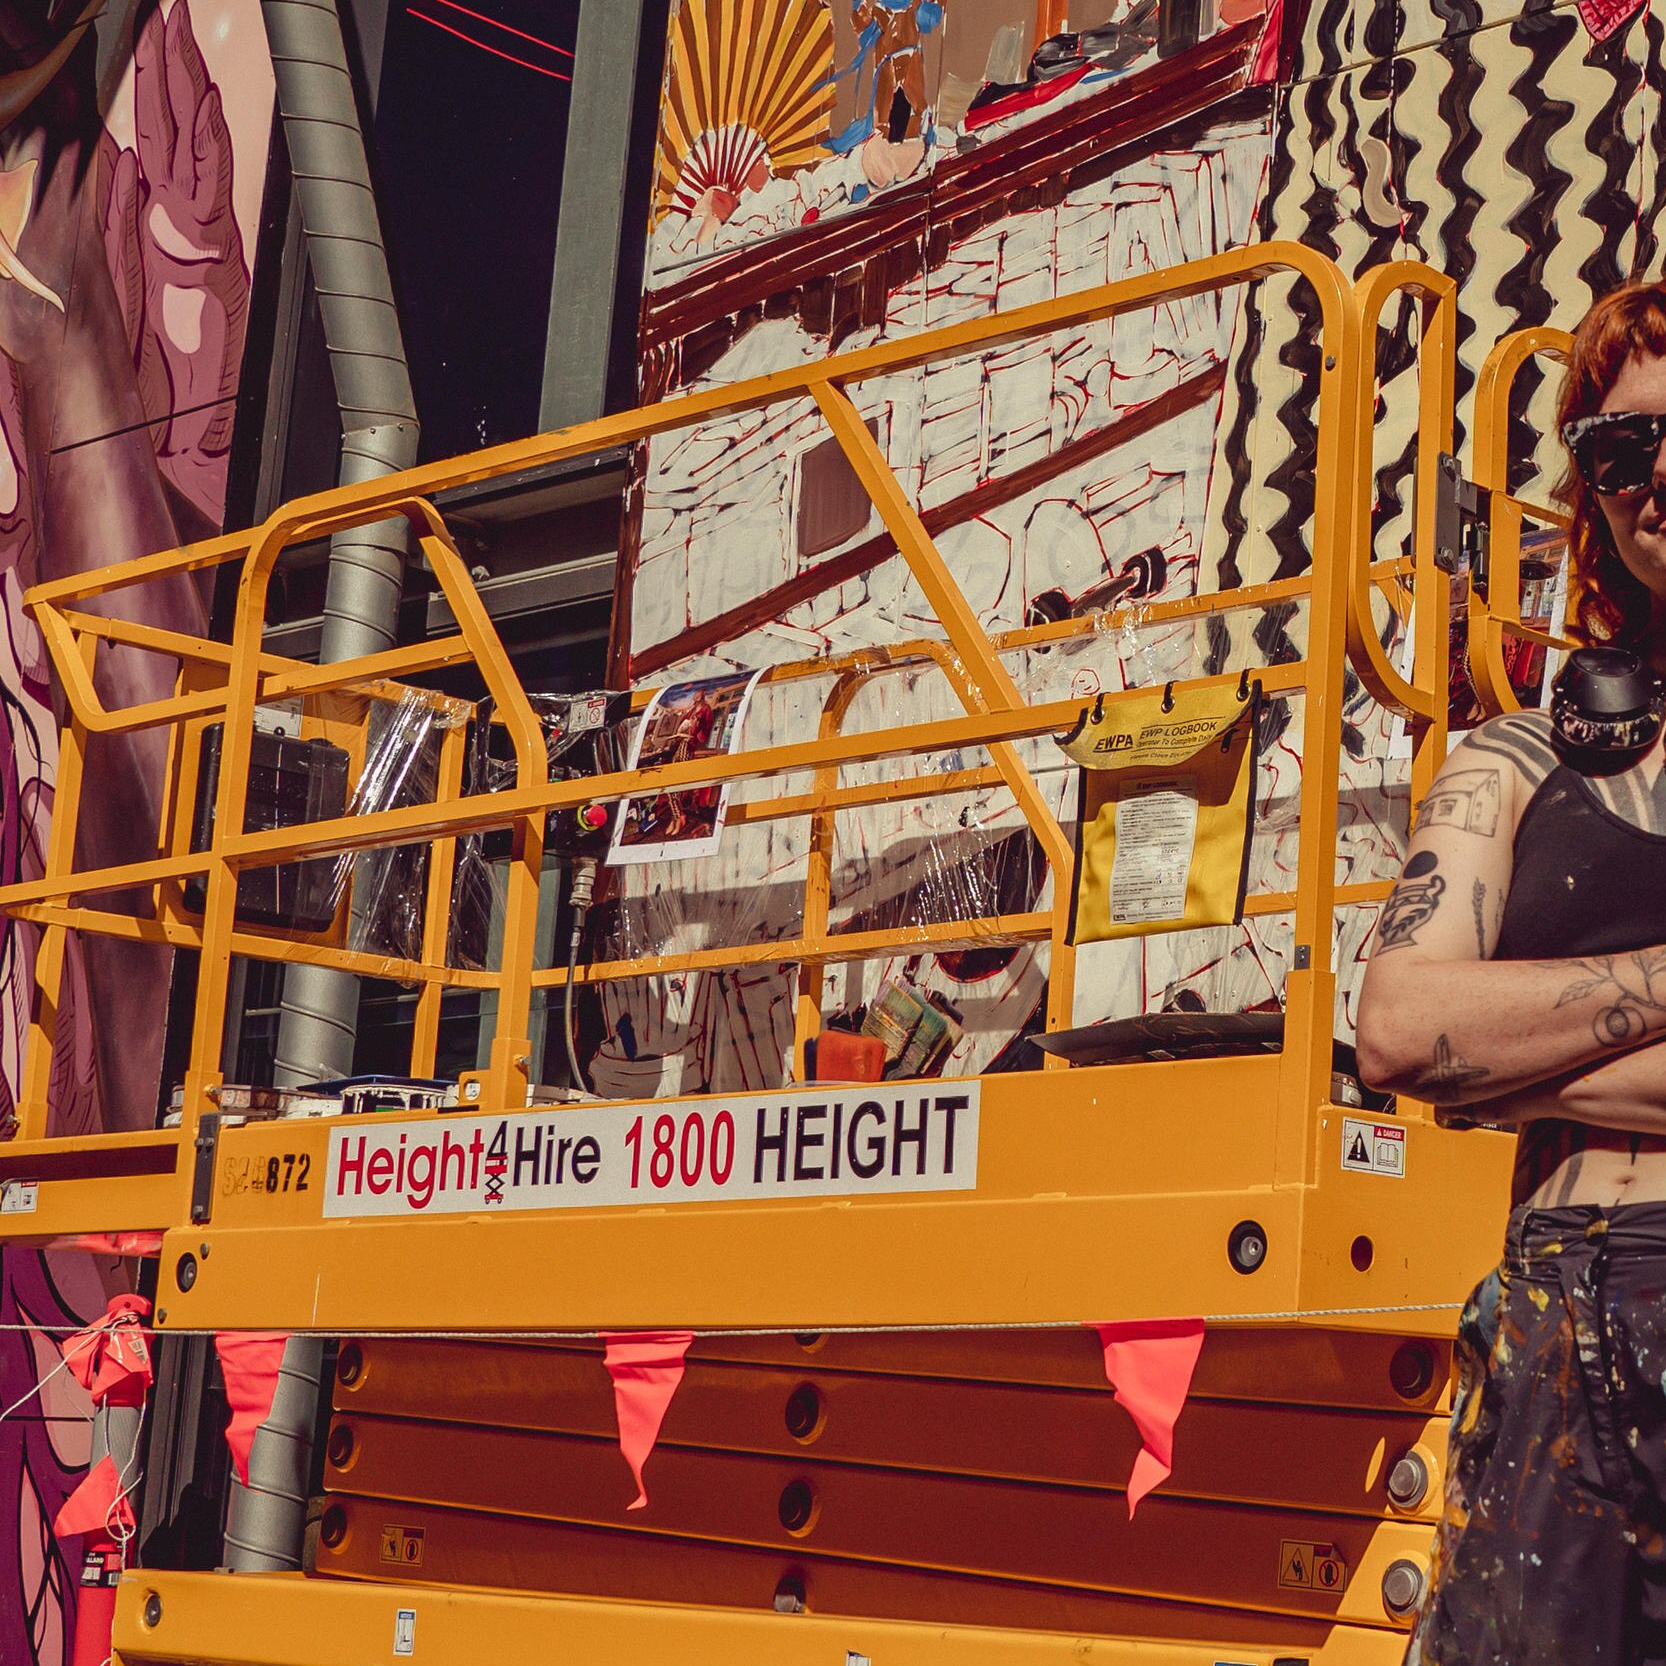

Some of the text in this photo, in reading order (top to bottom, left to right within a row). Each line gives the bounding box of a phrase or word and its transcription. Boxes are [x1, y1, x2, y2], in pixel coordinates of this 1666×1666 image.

[1139, 722, 1217, 739] EWP LOGBOOK
[1095, 734, 1133, 750] EWPA
[625, 1110, 735, 1189] 1800
[753, 1095, 970, 1184] HEIGHT
